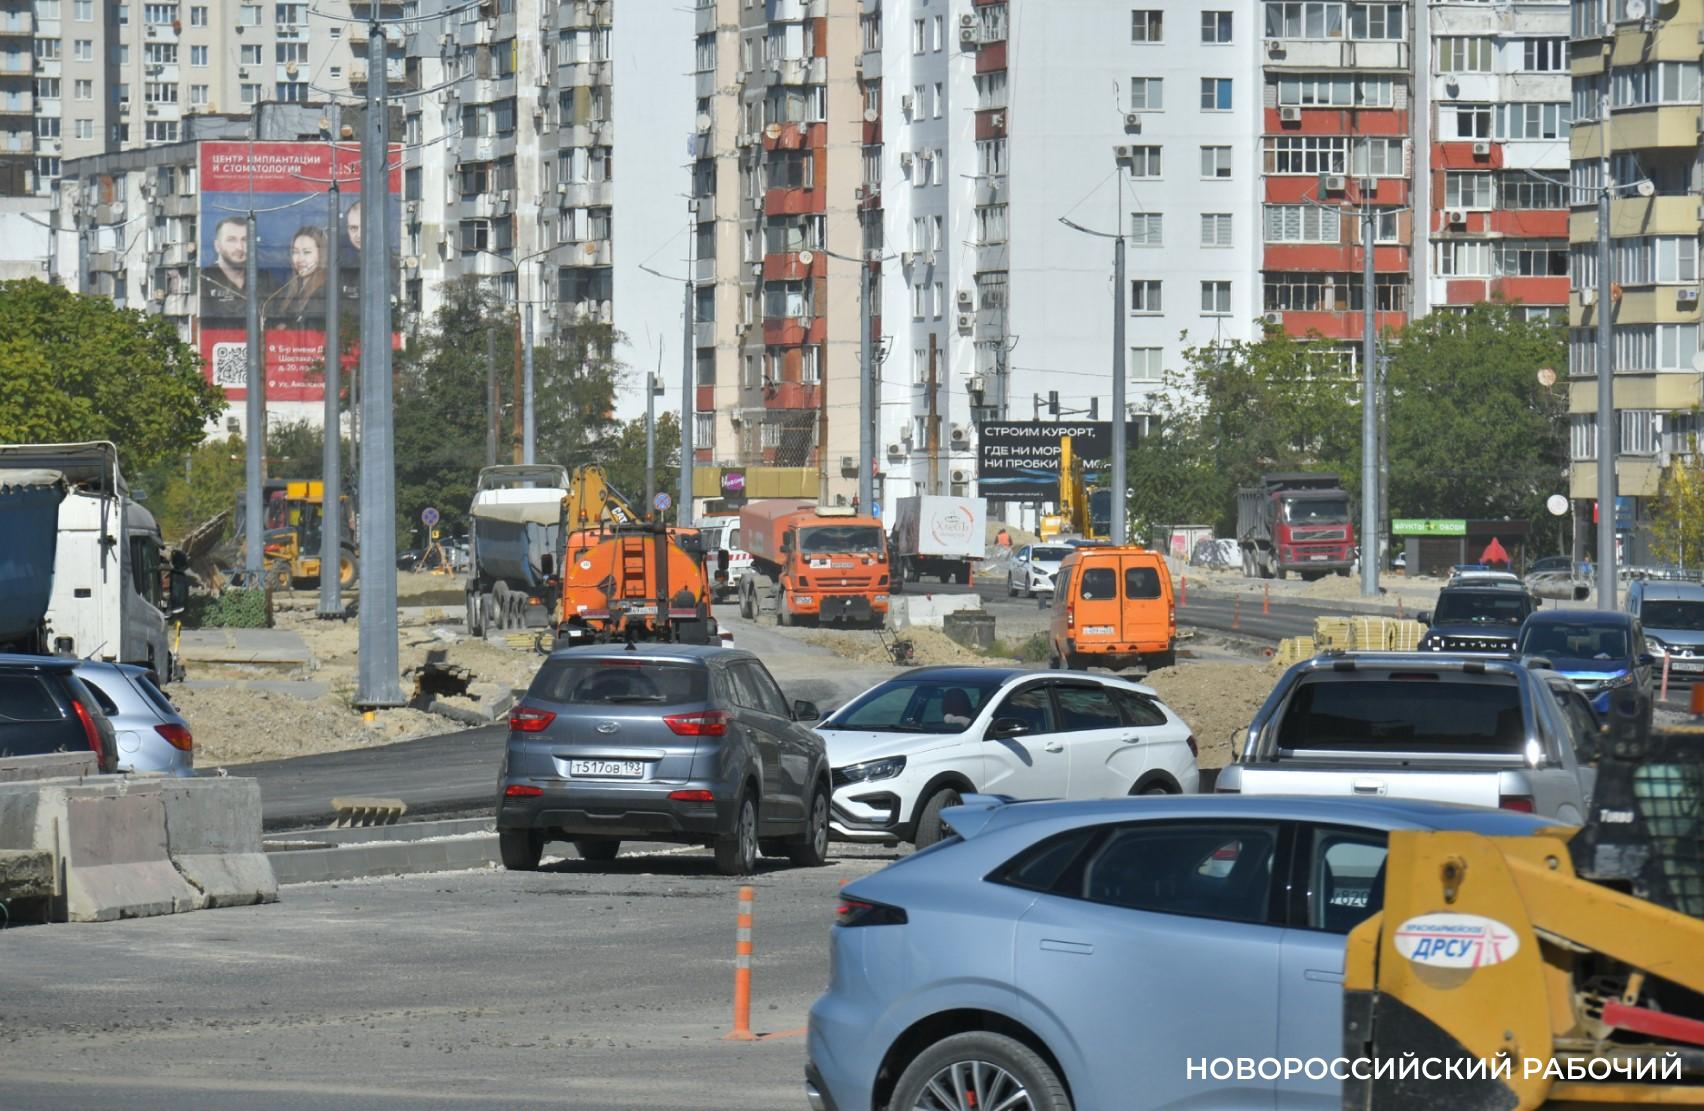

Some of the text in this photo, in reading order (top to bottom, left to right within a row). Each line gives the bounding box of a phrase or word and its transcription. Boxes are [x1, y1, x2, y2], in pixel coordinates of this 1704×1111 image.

[212, 155, 243, 164] ЦЕНТР
[223, 165, 302, 173] СТОМАТОЛОГИИ
[985, 427, 1096, 438] СТРОИМ КУРОРТ,
[984, 446, 1008, 456] ГДЕ
[1012, 446, 1030, 456] НИ
[985, 459, 1003, 468] НИ
[1006, 459, 1058, 468] ПРОБКИ
[624, 760, 641, 772] 193
[1411, 938, 1474, 960] ДРСУ
